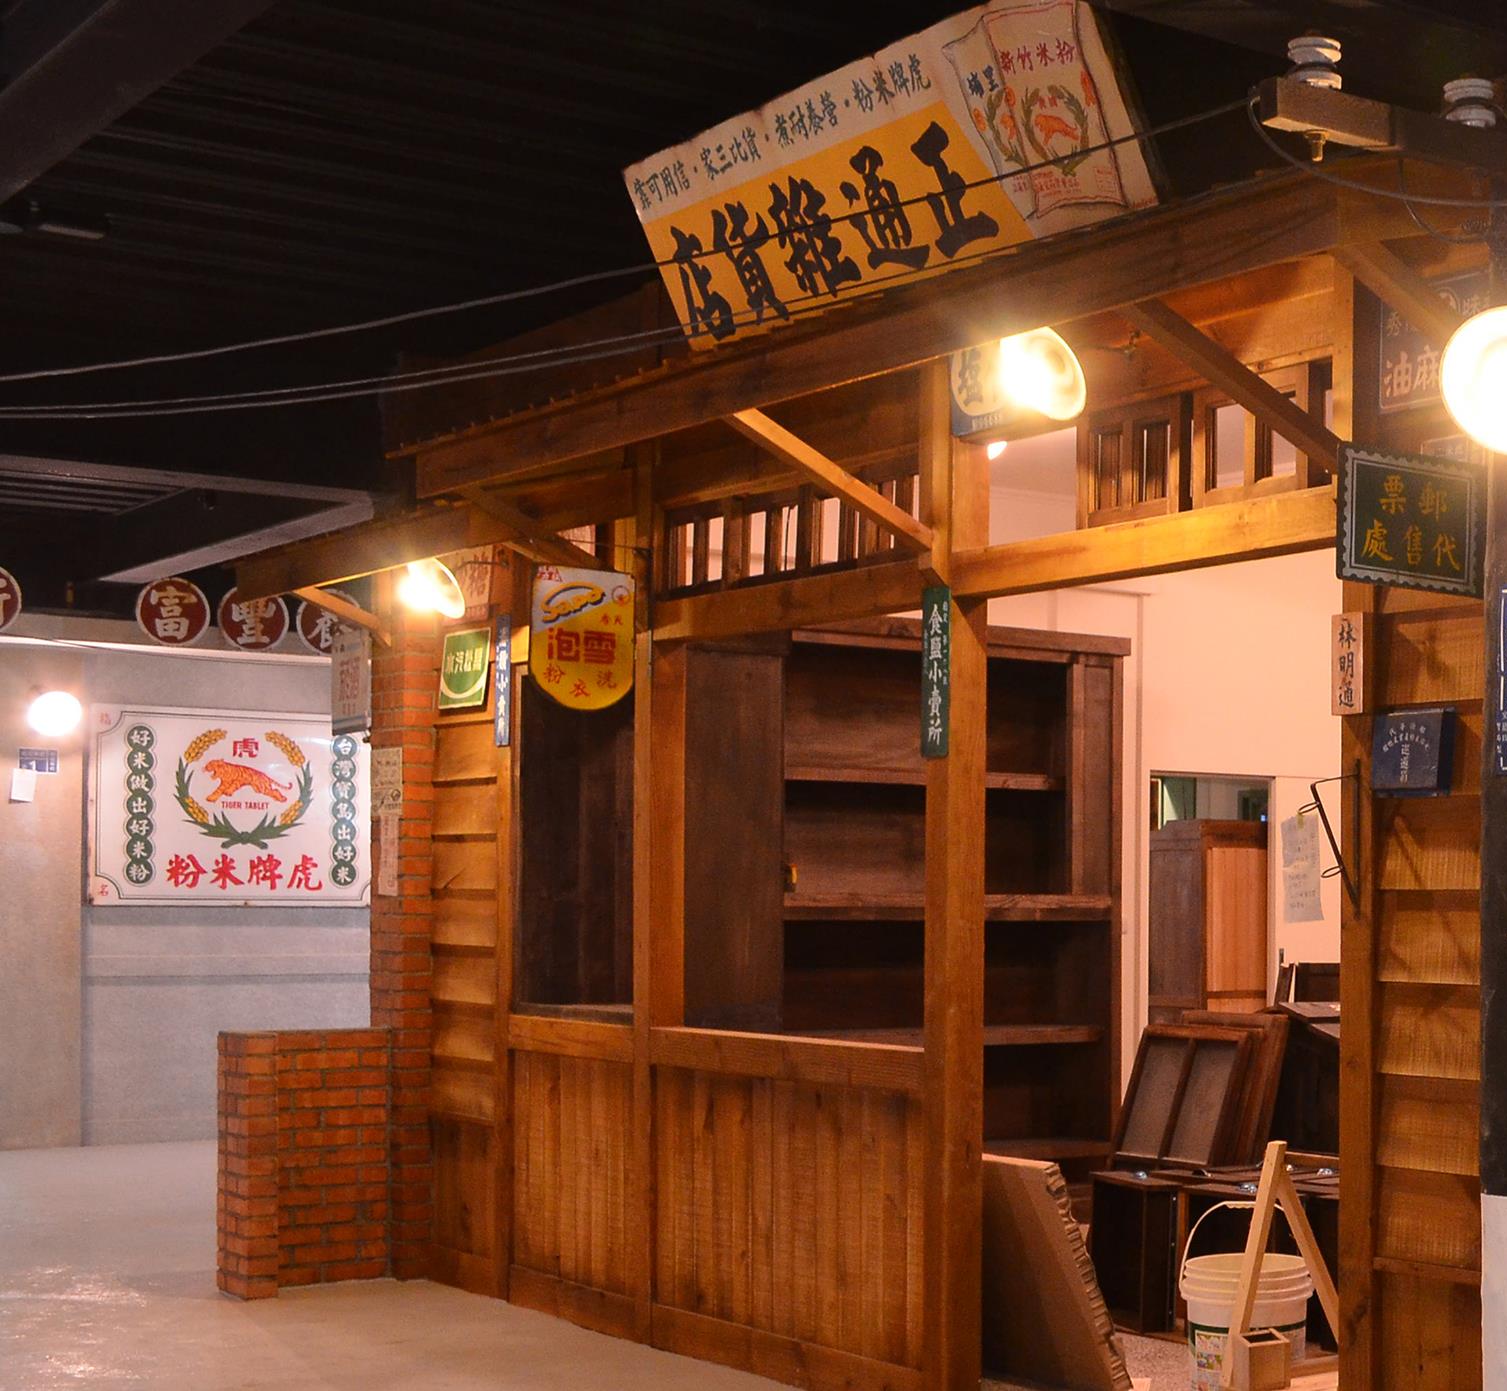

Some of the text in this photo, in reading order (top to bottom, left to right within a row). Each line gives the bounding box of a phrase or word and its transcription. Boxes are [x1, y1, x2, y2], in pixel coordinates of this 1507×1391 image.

[232, 738, 259, 758] 虎
[129, 729, 151, 880] 好米做出好米粉
[221, 801, 269, 810] TIGER TABLET
[166, 853, 324, 891] 虎牌米粉
